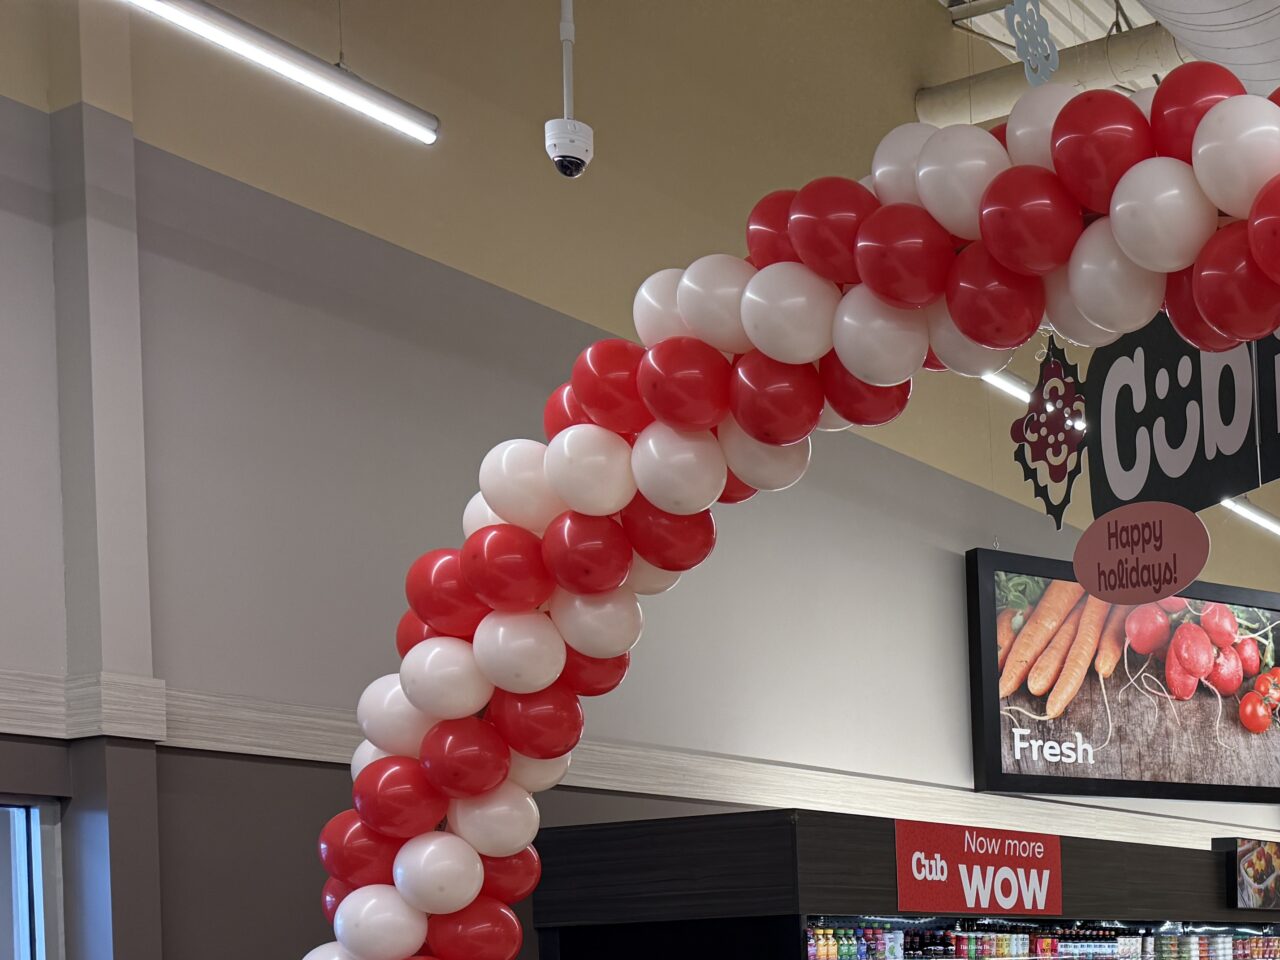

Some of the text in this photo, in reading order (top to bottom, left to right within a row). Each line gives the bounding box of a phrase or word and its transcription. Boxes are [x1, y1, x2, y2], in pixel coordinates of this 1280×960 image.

[1107, 518, 1163, 552] Happy
[1097, 553, 1178, 594] holidays!
[1011, 727, 1095, 765] Fresh
[964, 830, 1044, 859] Now more
[911, 851, 948, 882] Cub
[958, 863, 1050, 910] WOW
